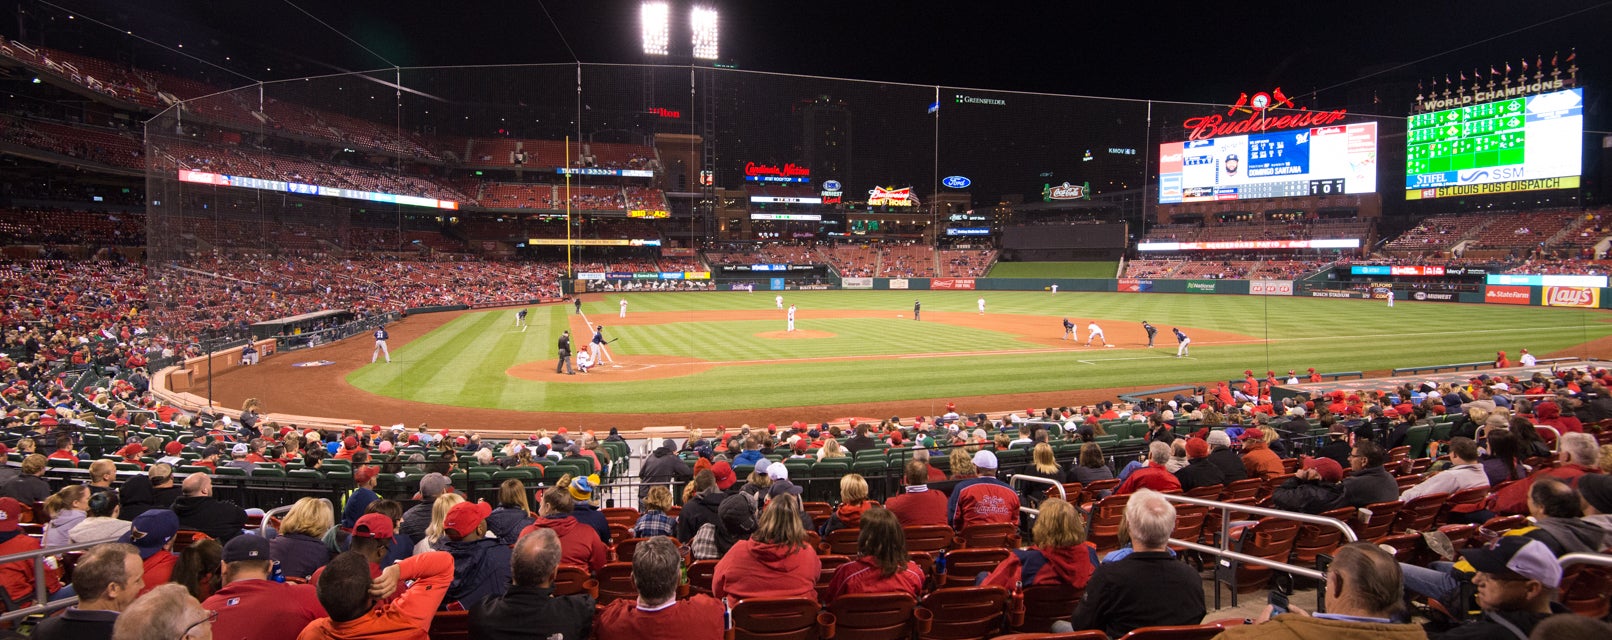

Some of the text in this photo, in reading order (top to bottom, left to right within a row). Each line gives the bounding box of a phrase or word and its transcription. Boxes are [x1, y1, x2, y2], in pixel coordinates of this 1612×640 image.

[964, 96, 1006, 105] GREENSFELDER
[1424, 79, 1563, 111] WORLD CHAMPIONS
[1183, 107, 1347, 140] Budweiser
[780, 163, 810, 176] Nation
[1249, 166, 1302, 176] DOMINGO SANTANA
[1492, 166, 1525, 180] SSM
[948, 177, 966, 186] Ford
[1417, 173, 1447, 184] STIFEL
[1053, 187, 1079, 197] Coca-Cola
[1311, 184, 1342, 194] 1 0 1
[1439, 187, 1451, 196] ST.
[1453, 184, 1479, 195] LOUIS
[1482, 178, 1560, 193] POST-DISPATCH
[868, 189, 910, 199] Budweiser
[975, 503, 1008, 514] Cardinals
